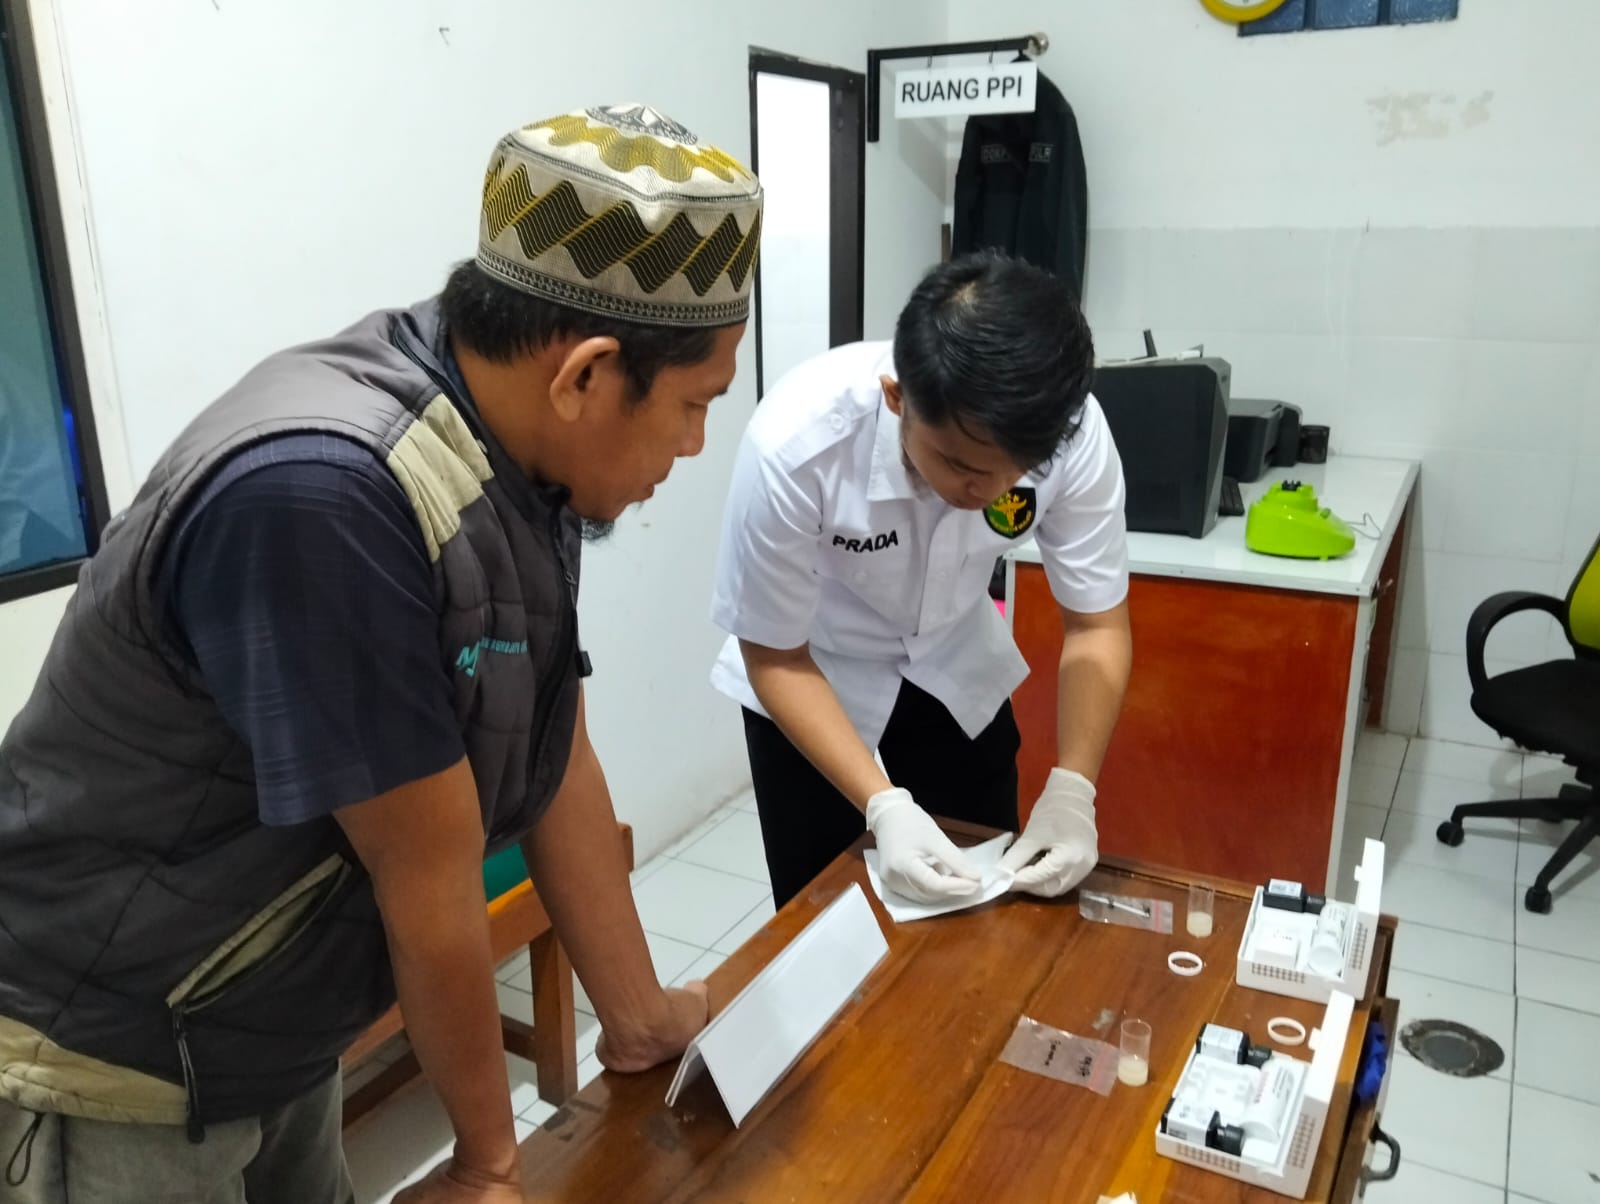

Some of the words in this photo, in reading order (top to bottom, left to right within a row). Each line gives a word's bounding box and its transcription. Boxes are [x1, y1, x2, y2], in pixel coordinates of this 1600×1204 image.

[902, 78, 979, 103] RUANG
[987, 76, 1022, 98] PPI
[832, 529, 899, 553] PRADA
